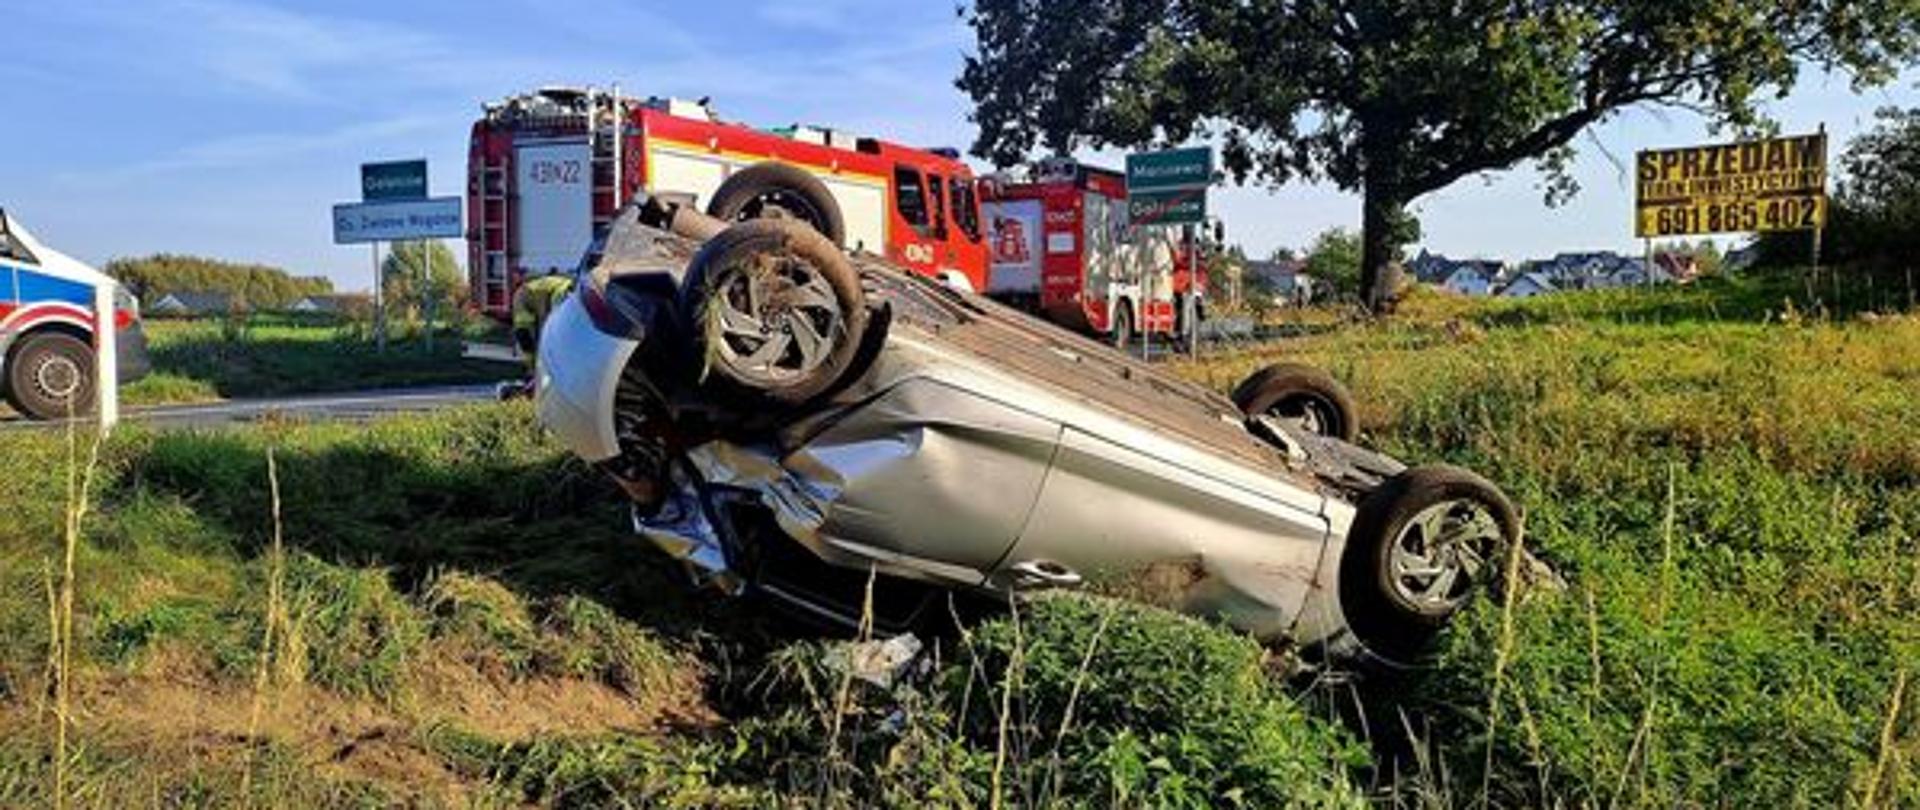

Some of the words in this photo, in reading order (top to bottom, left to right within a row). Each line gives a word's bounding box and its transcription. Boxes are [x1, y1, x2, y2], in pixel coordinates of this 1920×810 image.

[1640, 136, 1822, 180] SPRZEDAM
[1657, 207, 1700, 234] 691
[1708, 202, 1758, 231] 865
[1766, 198, 1816, 229] 402
